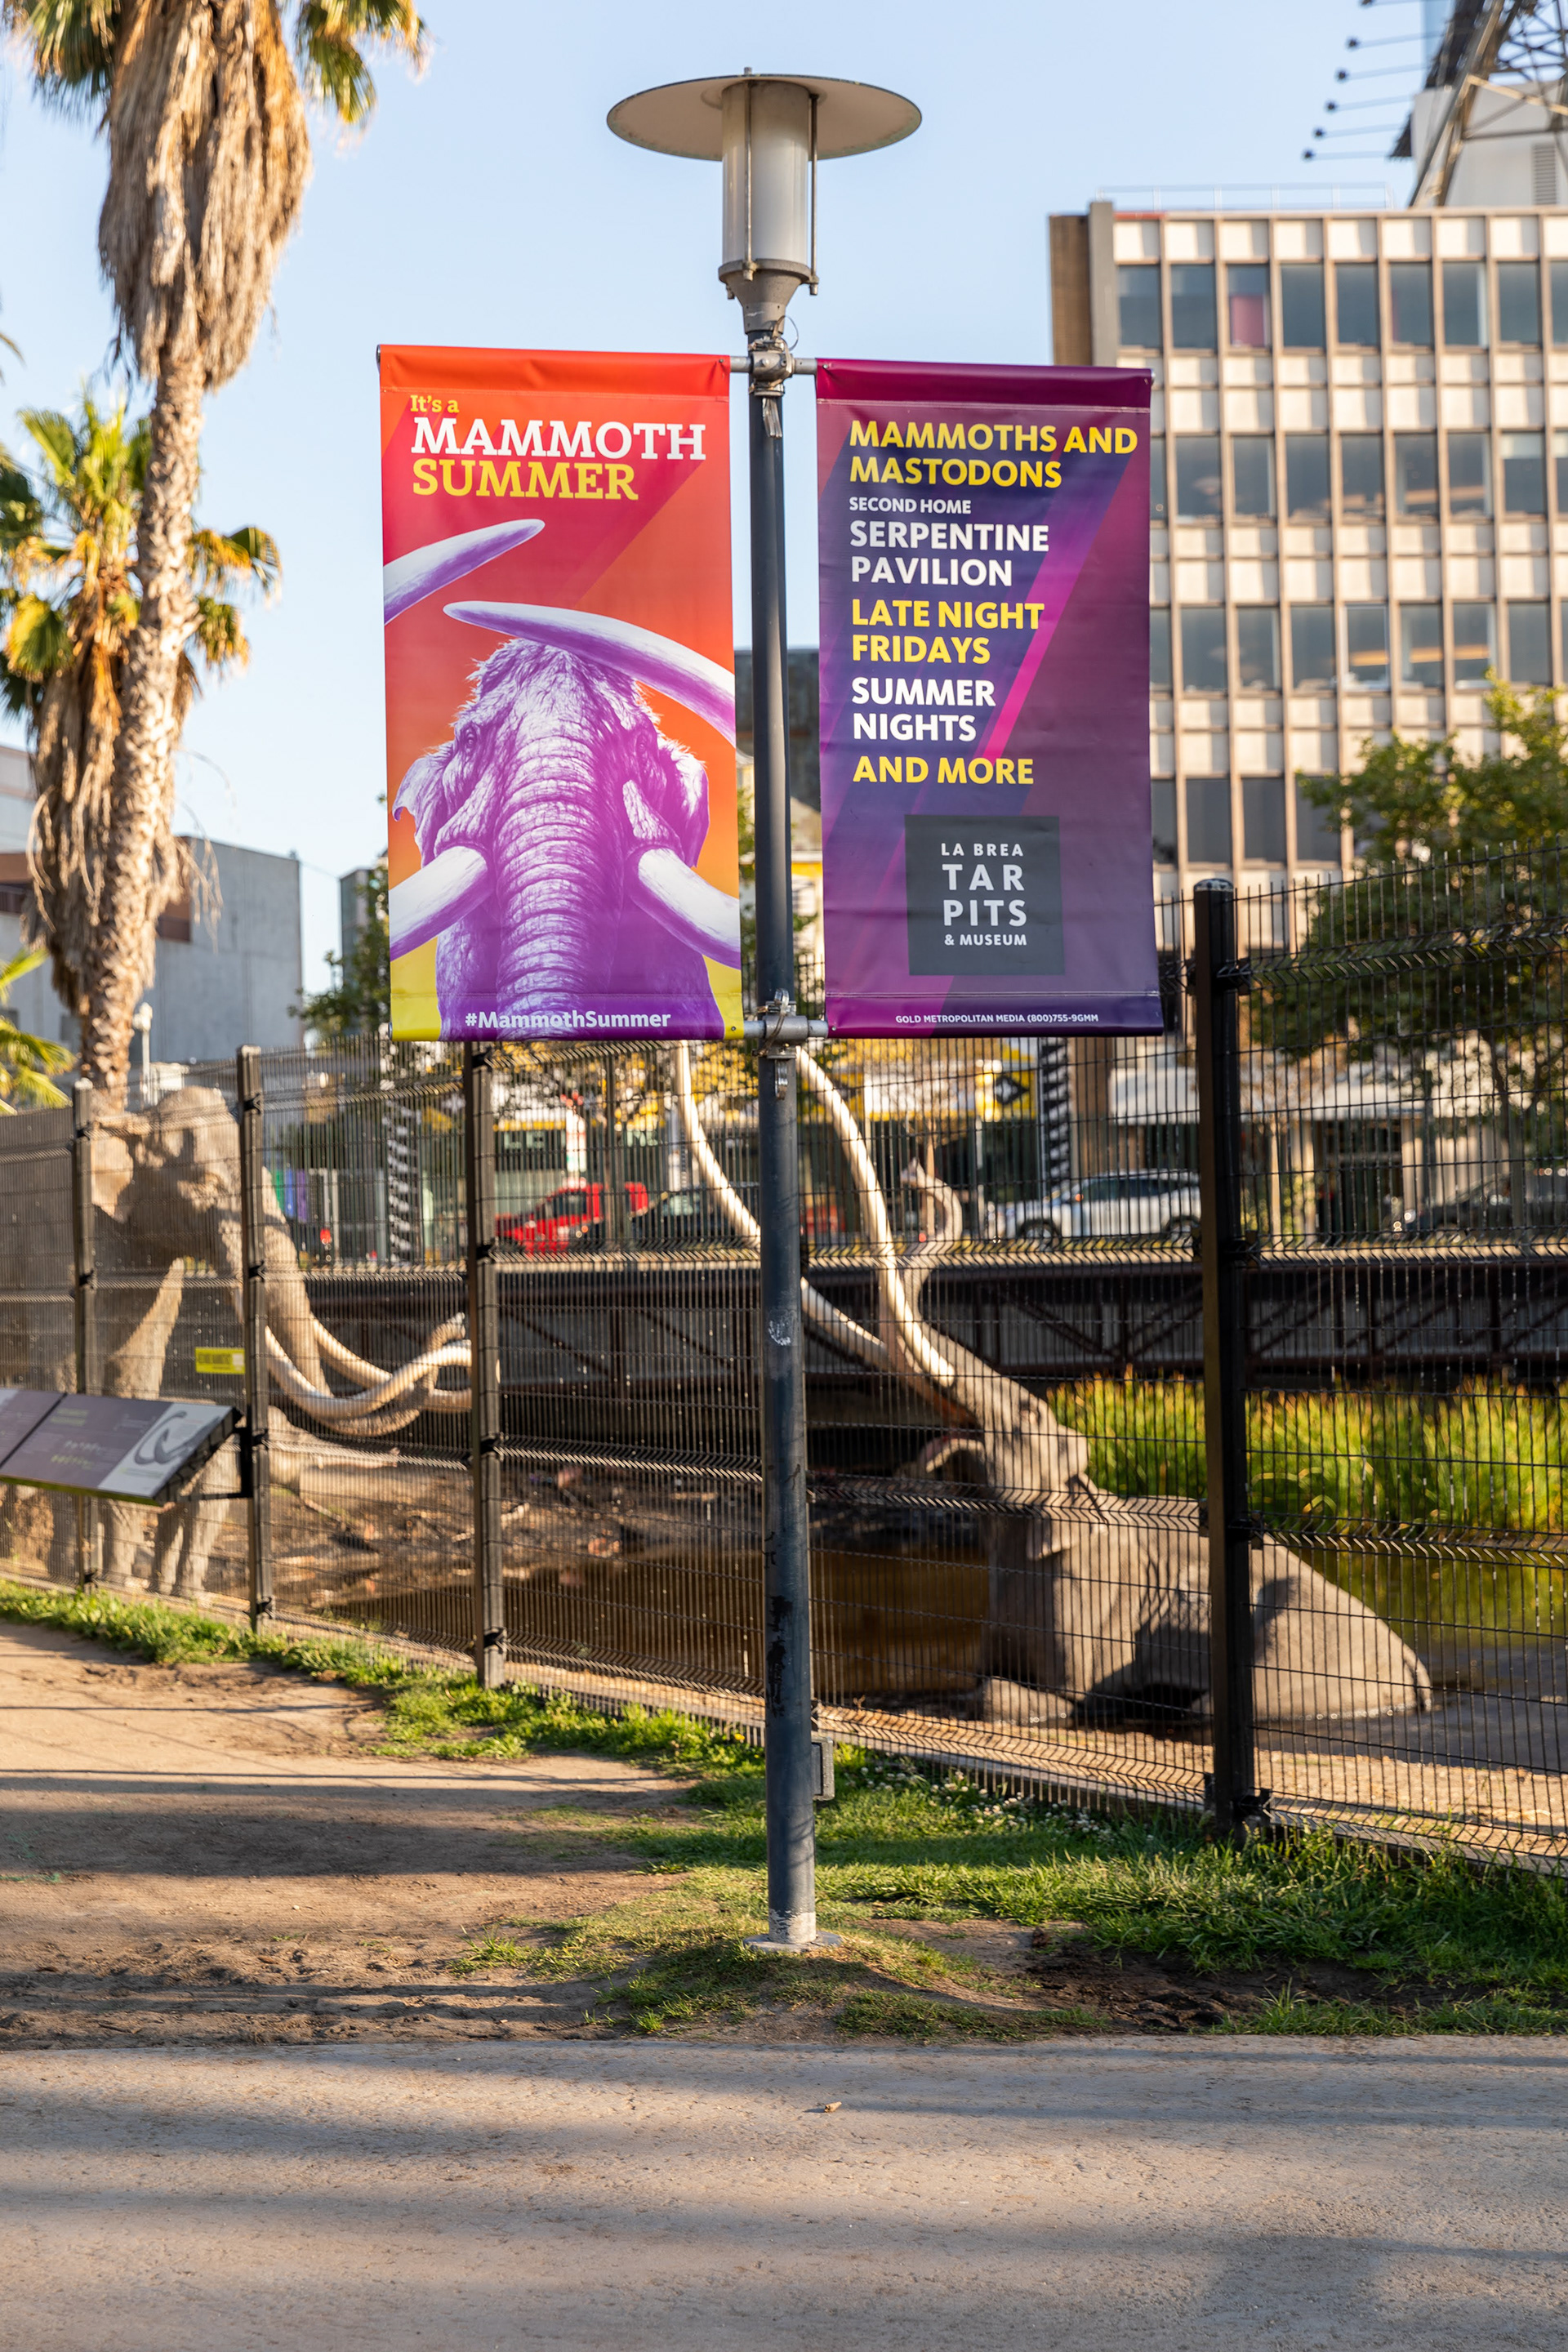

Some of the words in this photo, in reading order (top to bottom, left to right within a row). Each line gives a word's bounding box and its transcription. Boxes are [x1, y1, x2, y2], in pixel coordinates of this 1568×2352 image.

[411, 394, 442, 413] It's
[447, 399, 460, 413] a
[411, 417, 706, 460] MAMMOTH
[849, 420, 1058, 452] MAMMOTHS
[1063, 426, 1138, 454] AND
[412, 458, 639, 501] SUMMER
[849, 456, 1062, 488] MASTODONS
[849, 497, 917, 513] SECOND
[920, 498, 972, 514] HOME
[850, 519, 1049, 552] SERPENTINE
[852, 556, 1012, 586] PAVILION
[852, 599, 930, 627] LATE
[938, 601, 1045, 630] NIGHT
[853, 634, 991, 664] FRIDAYS
[852, 676, 996, 706] SUMMER
[853, 712, 977, 742] NIGHTS
[853, 755, 929, 783] AND
[937, 757, 1034, 785] MORE
[941, 843, 964, 856] LA
[973, 843, 1023, 857] BREA
[942, 863, 1025, 891] TAR
[943, 899, 1027, 927] PITS
[944, 933, 955, 946] &
[960, 933, 1027, 946] MUSEUM
[465, 1010, 671, 1029] #MammothSummer
[895, 1014, 922, 1024] GOLD
[923, 1014, 994, 1023] METROPOLITAN
[996, 1014, 1026, 1022] MEDIA
[1027, 1013, 1099, 1023] (800)755-9GMM
